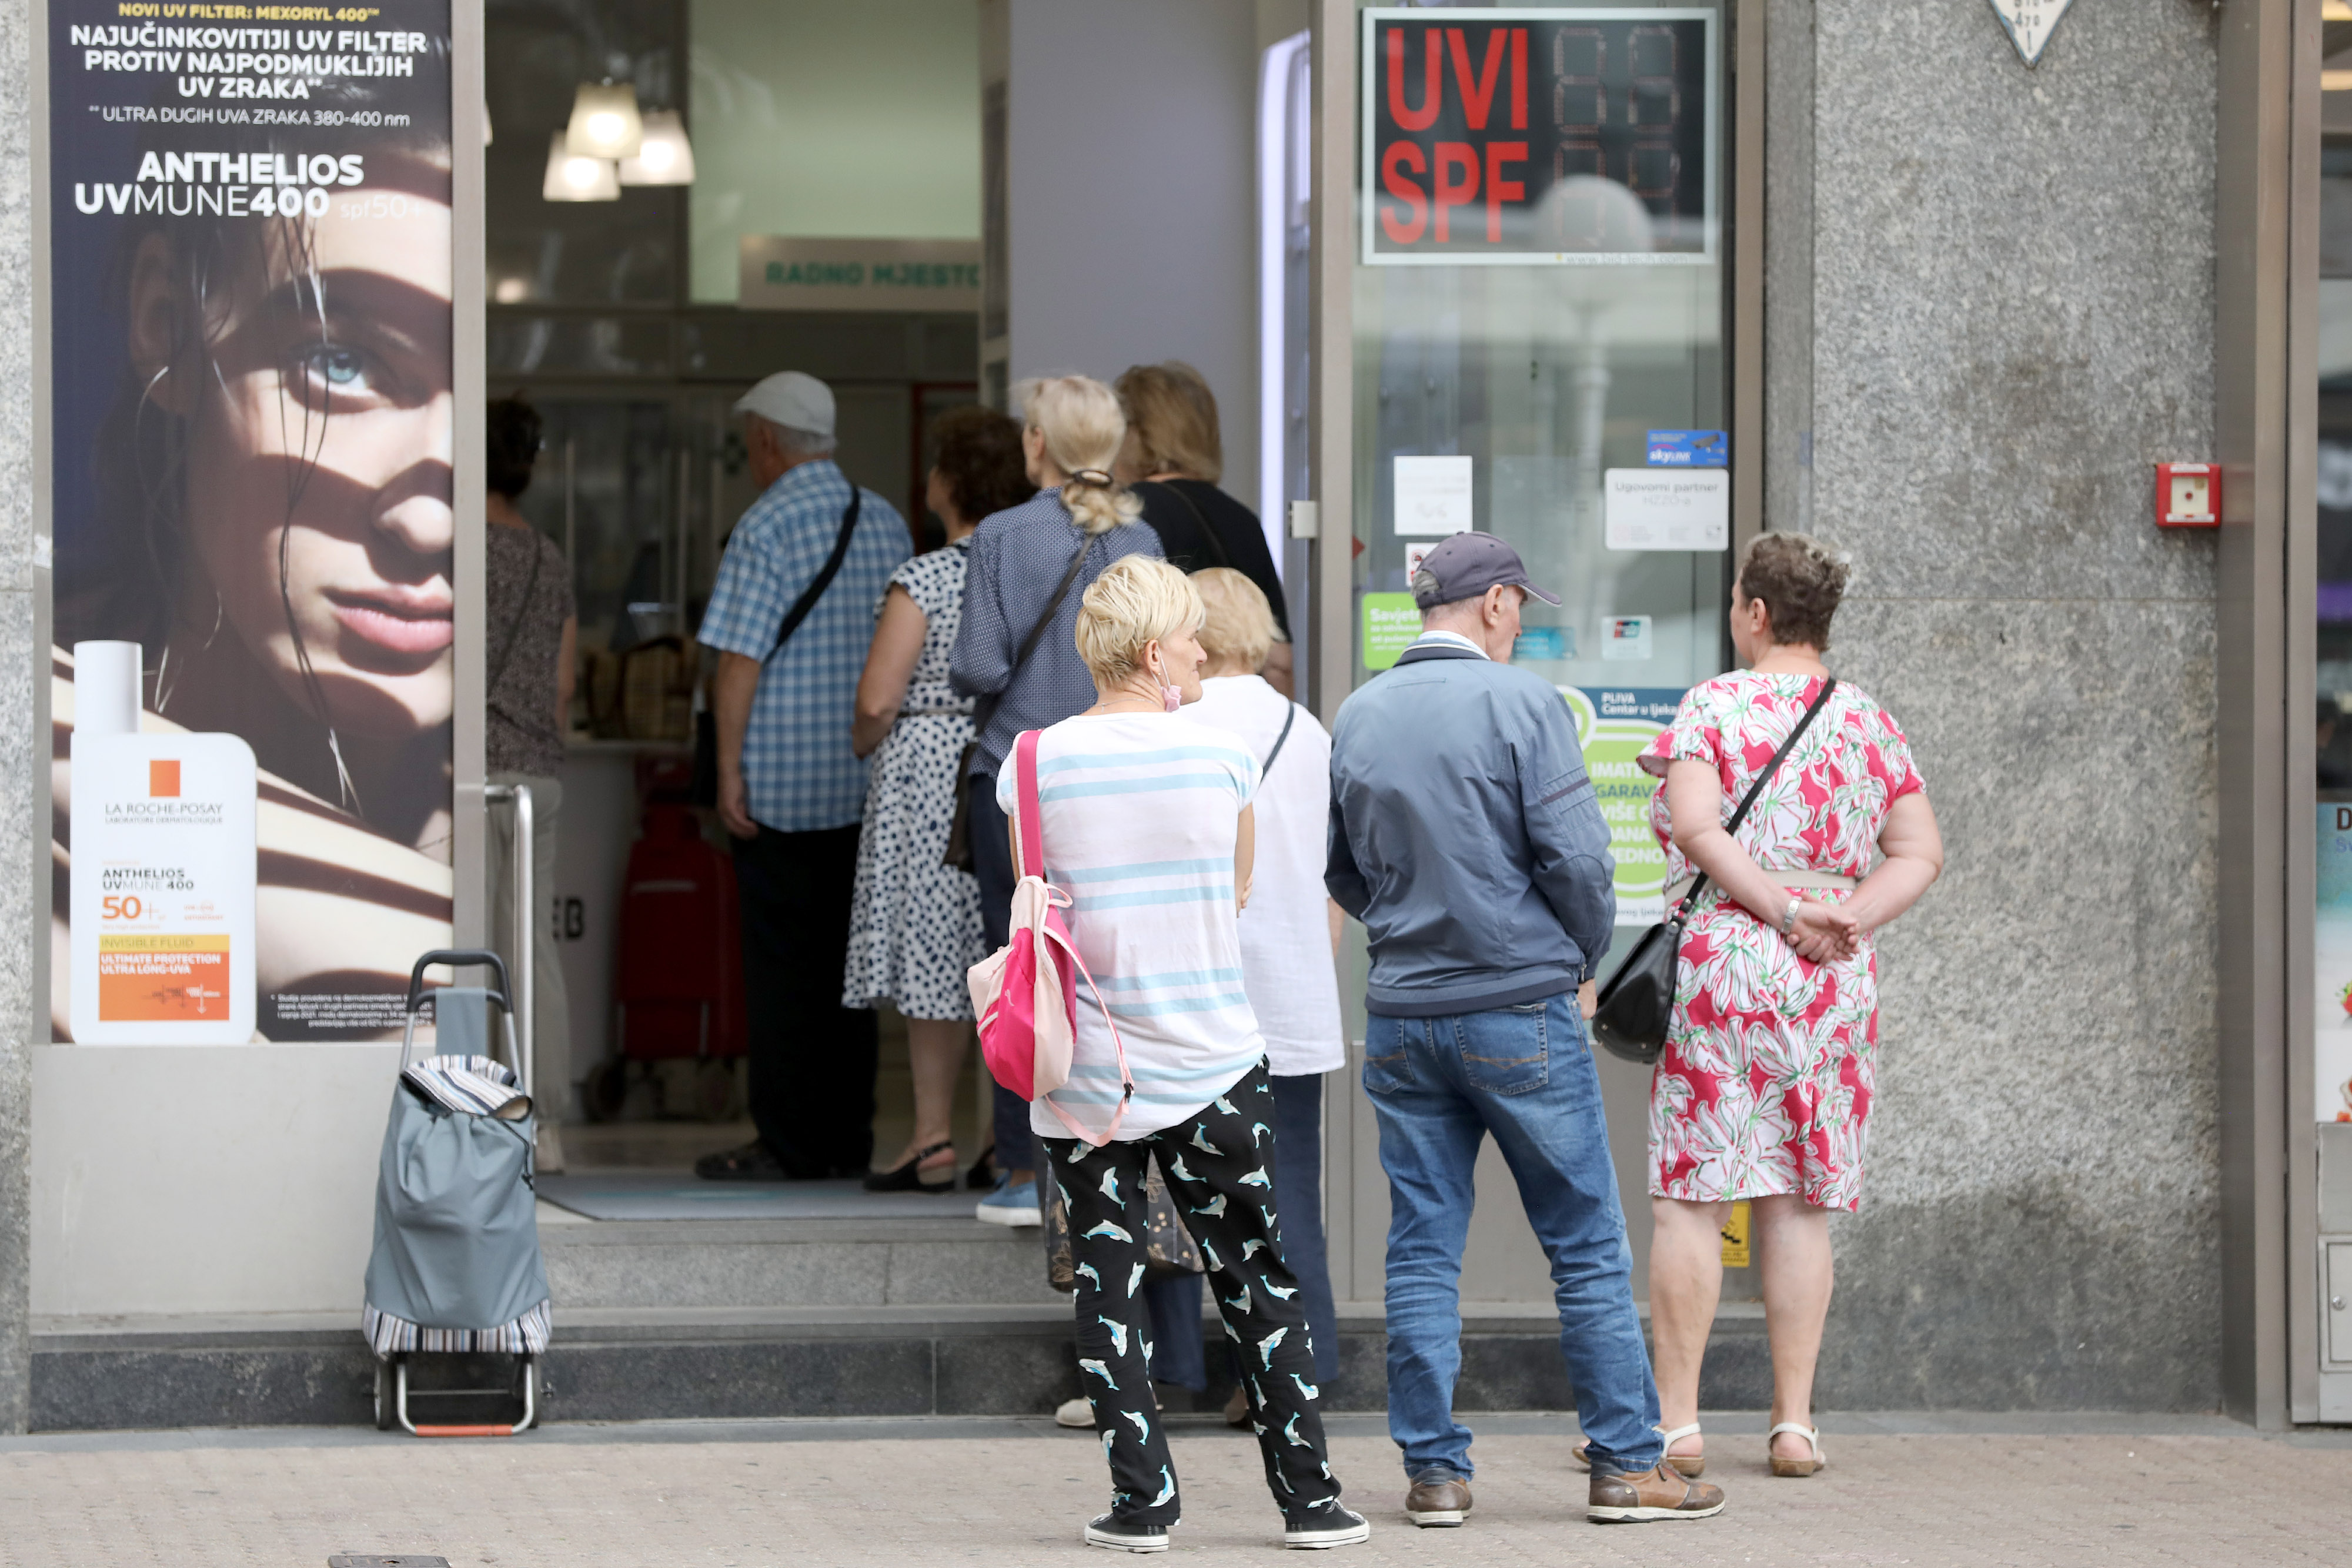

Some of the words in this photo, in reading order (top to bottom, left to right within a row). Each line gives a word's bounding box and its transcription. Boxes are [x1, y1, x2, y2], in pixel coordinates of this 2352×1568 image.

[119, 3, 160, 17] NOVI
[163, 4, 186, 18] UV
[189, 5, 253, 19] FILTER:
[256, 6, 333, 21] MEXORYL
[71, 21, 290, 50] NAJUČINKOVITIJI
[296, 31, 332, 51] UV
[338, 31, 426, 53] FILTER
[85, 51, 182, 71] PROTIV
[188, 53, 413, 76] NAJPODMUKLIJIH
[178, 77, 215, 98] UV
[1387, 27, 1529, 132] UVI
[103, 106, 158, 122] ULTRA
[161, 108, 213, 123] DUGIH
[216, 109, 250, 124] UVA
[253, 109, 311, 125] ZRAKA
[314, 111, 382, 126] 380-400
[385, 114, 410, 126] nm
[136, 151, 365, 186] ANTHELIOS
[1379, 140, 1529, 244] SPF
[766, 262, 864, 286] RADNO
[1615, 481, 1670, 494] Ugovorni
[1673, 482, 1718, 494] partner
[1601, 692, 1635, 704] PLIVA
[1601, 704, 1639, 715] Centar
[1591, 761, 1645, 778] IMATE
[1595, 783, 1656, 798] GARAV
[105, 803, 121, 814] LA
[126, 803, 223, 815] ROCHE-POSAY
[1611, 826, 1651, 842] ANA
[103, 869, 185, 879] ANTHELIOS
[168, 881, 193, 891] 400
[102, 937, 157, 948] INVISIBLE
[160, 937, 193, 948] FLUID
[101, 953, 152, 964] ULTIMATE
[153, 953, 220, 965] PROTECTION
[101, 964, 135, 975] ULTRA
